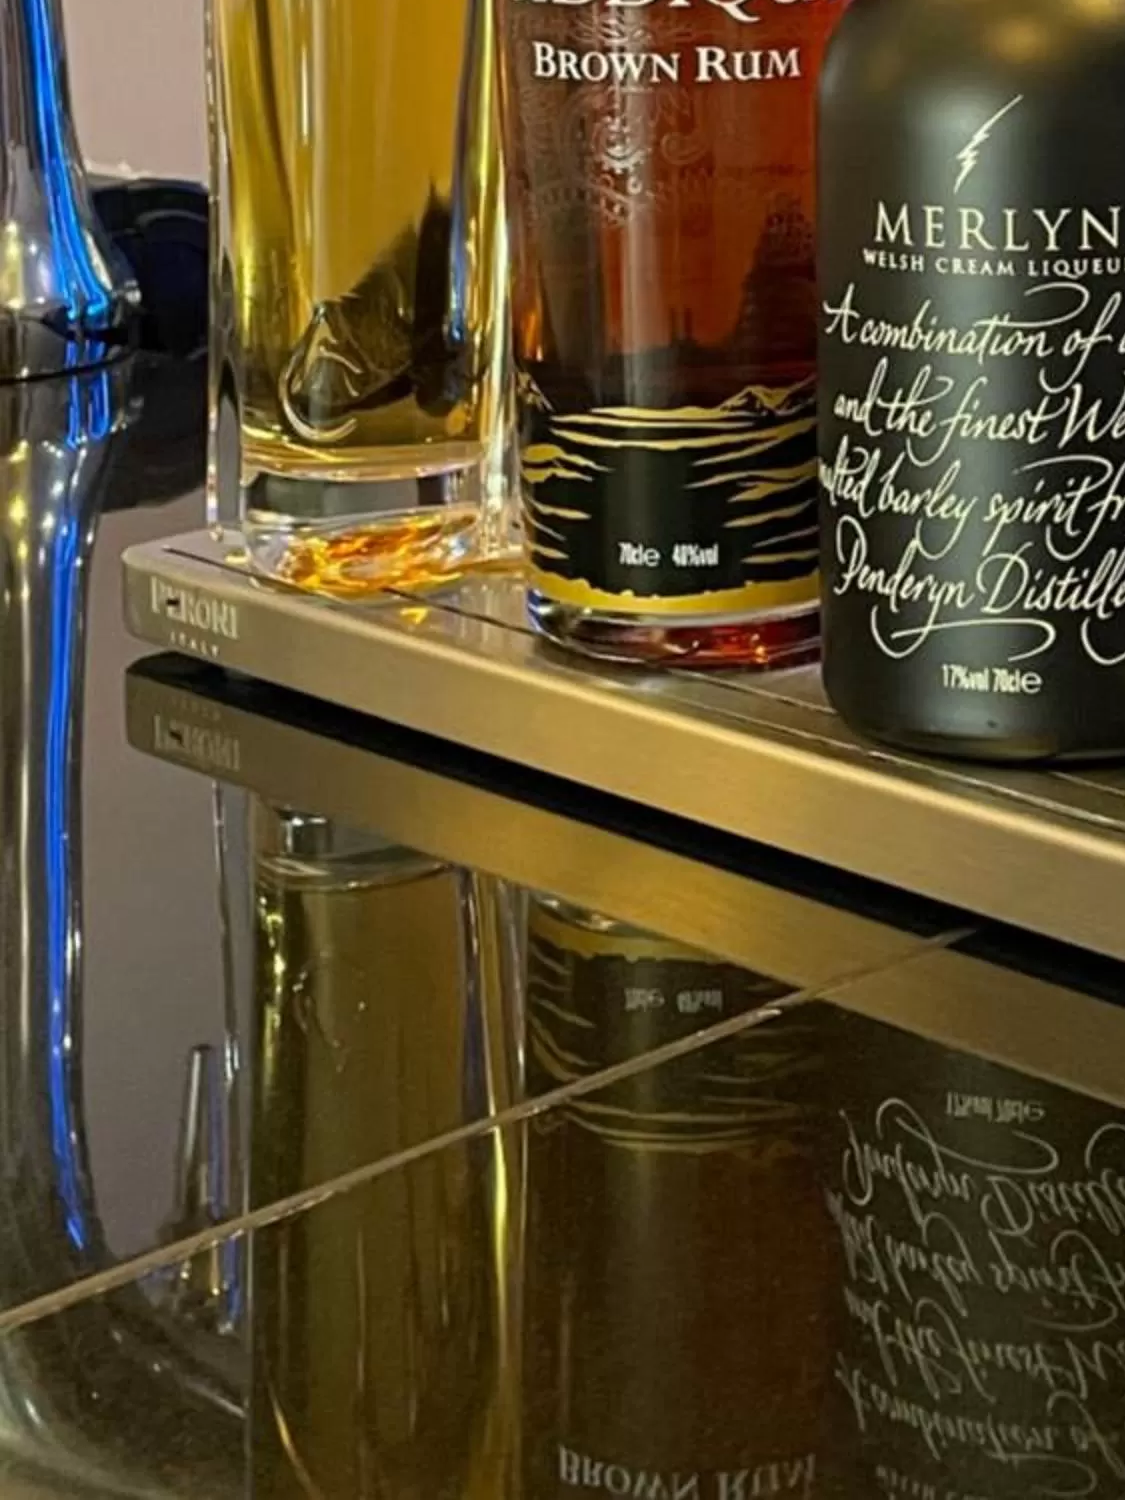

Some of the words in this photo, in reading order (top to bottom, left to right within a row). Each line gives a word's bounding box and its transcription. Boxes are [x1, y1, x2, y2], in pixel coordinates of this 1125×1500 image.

[532, 40, 681, 84] BROWN
[694, 45, 802, 83] RUM
[863, 248, 925, 273] WELSH
[935, 257, 1015, 276] CREAM
[875, 201, 1121, 251] MERLYN
[822, 282, 859, 344] A
[859, 281, 1091, 365] combination
[1039, 291, 1122, 394] of
[833, 355, 888, 436] and
[877, 364, 955, 438] the
[906, 375, 1070, 467] finest
[880, 452, 978, 560] barley
[983, 454, 1113, 556] spirit
